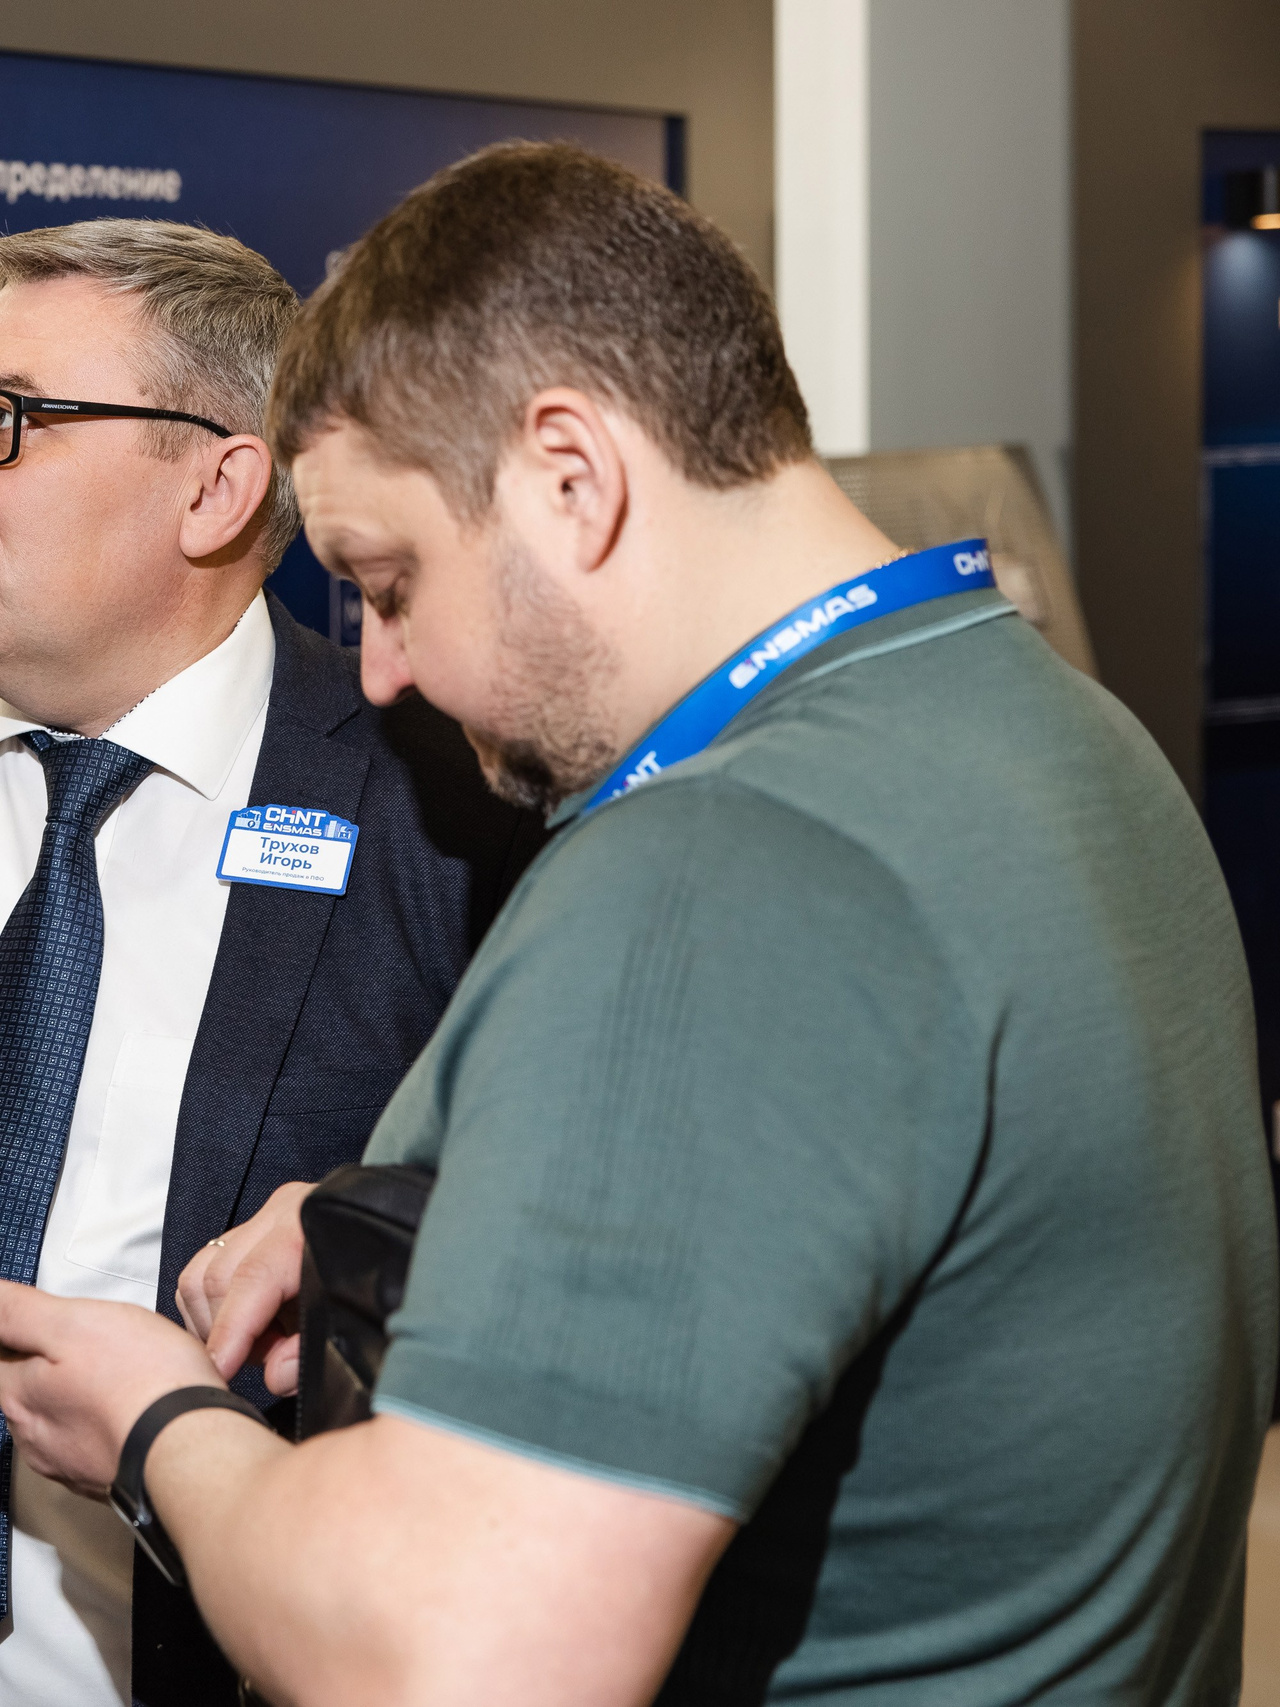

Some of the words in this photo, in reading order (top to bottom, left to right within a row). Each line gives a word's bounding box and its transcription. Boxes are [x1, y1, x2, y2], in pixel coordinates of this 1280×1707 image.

[263, 823, 322, 836] ENSMAS
[260, 836, 320, 855] Трухов
[259, 852, 312, 870] Игорь
[242, 867, 281, 876] Руководитель
